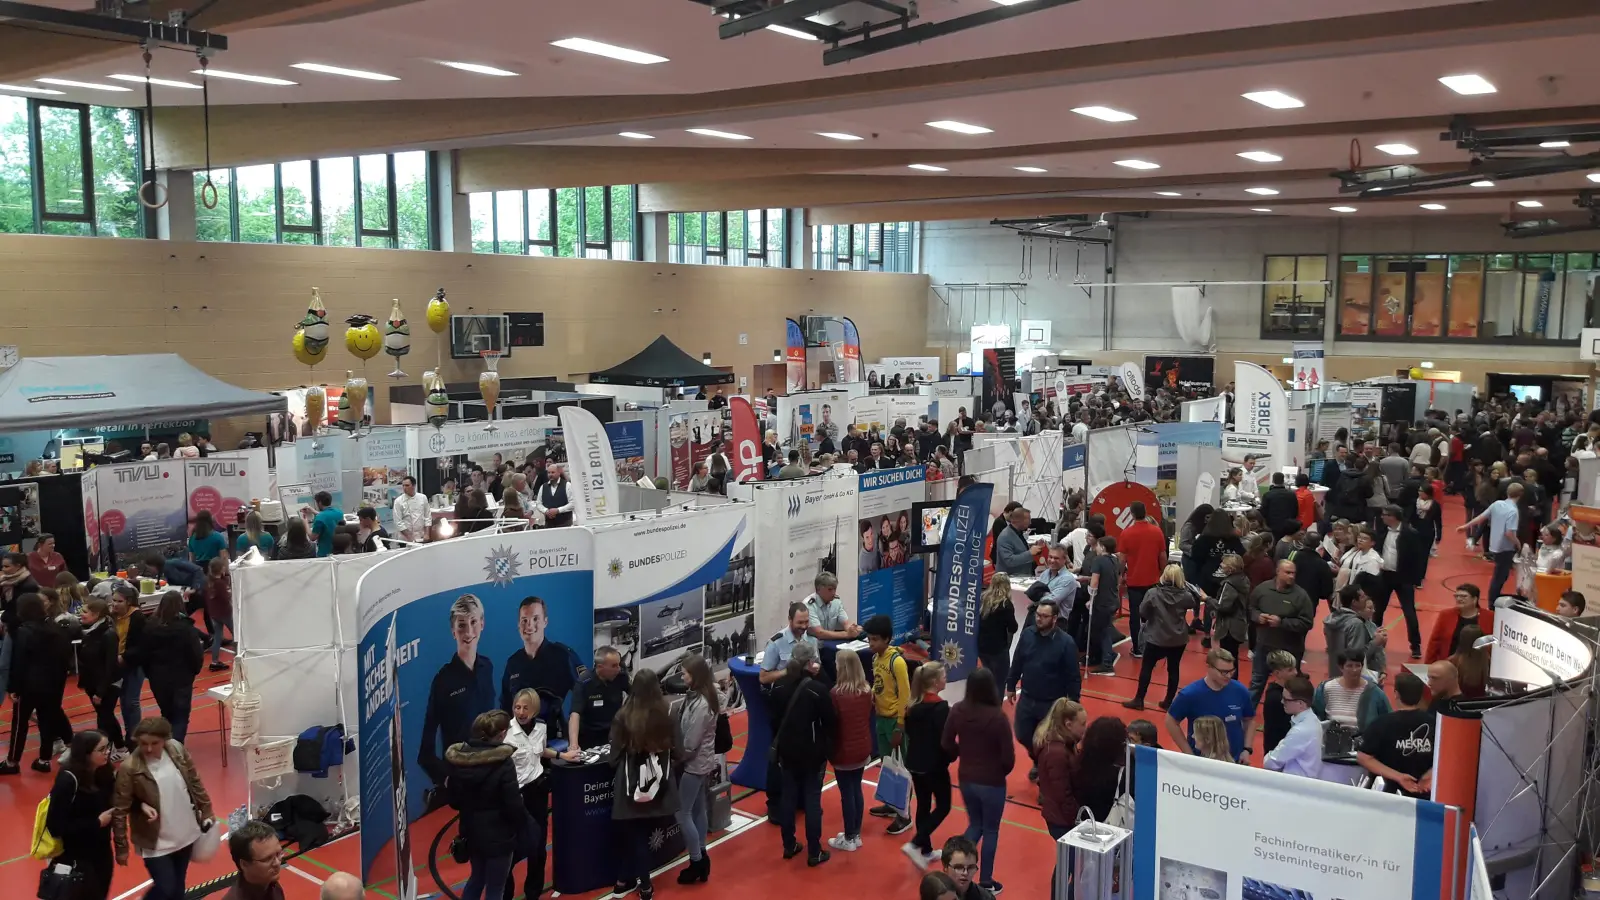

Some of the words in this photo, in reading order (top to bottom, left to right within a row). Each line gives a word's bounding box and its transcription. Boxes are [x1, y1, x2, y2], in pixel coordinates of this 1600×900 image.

[454, 434, 465, 443] Da
[503, 430, 518, 438] was
[863, 476, 878, 488] WIR
[878, 471, 904, 485] SUCHEN
[905, 468, 923, 481] DICH!
[804, 493, 822, 504] Bayer
[845, 489, 854, 497] KG
[633, 522, 687, 537] www.bundespolizei.de
[529, 553, 579, 569] POLIZEI
[538, 546, 568, 555] Bayerische
[628, 549, 688, 569] BUNDESPOLIZEI
[968, 531, 982, 576] POLICE
[946, 504, 970, 632] BUNDESPOLIZEI
[964, 575, 978, 636] FEDERAL
[1503, 624, 1528, 644] Starte
[1530, 635, 1554, 656] durch
[1556, 645, 1572, 666] beim
[364, 643, 376, 675] MIT
[364, 637, 420, 699] SICHEHEIT
[1395, 736, 1431, 750] MEKRA
[583, 780, 609, 793] Deine
[1161, 779, 1250, 811] neuberger.
[1253, 846, 1364, 881] Systemintegration
[1254, 832, 1378, 869] Fachinformatiker/-in
[1382, 860, 1401, 873] für
